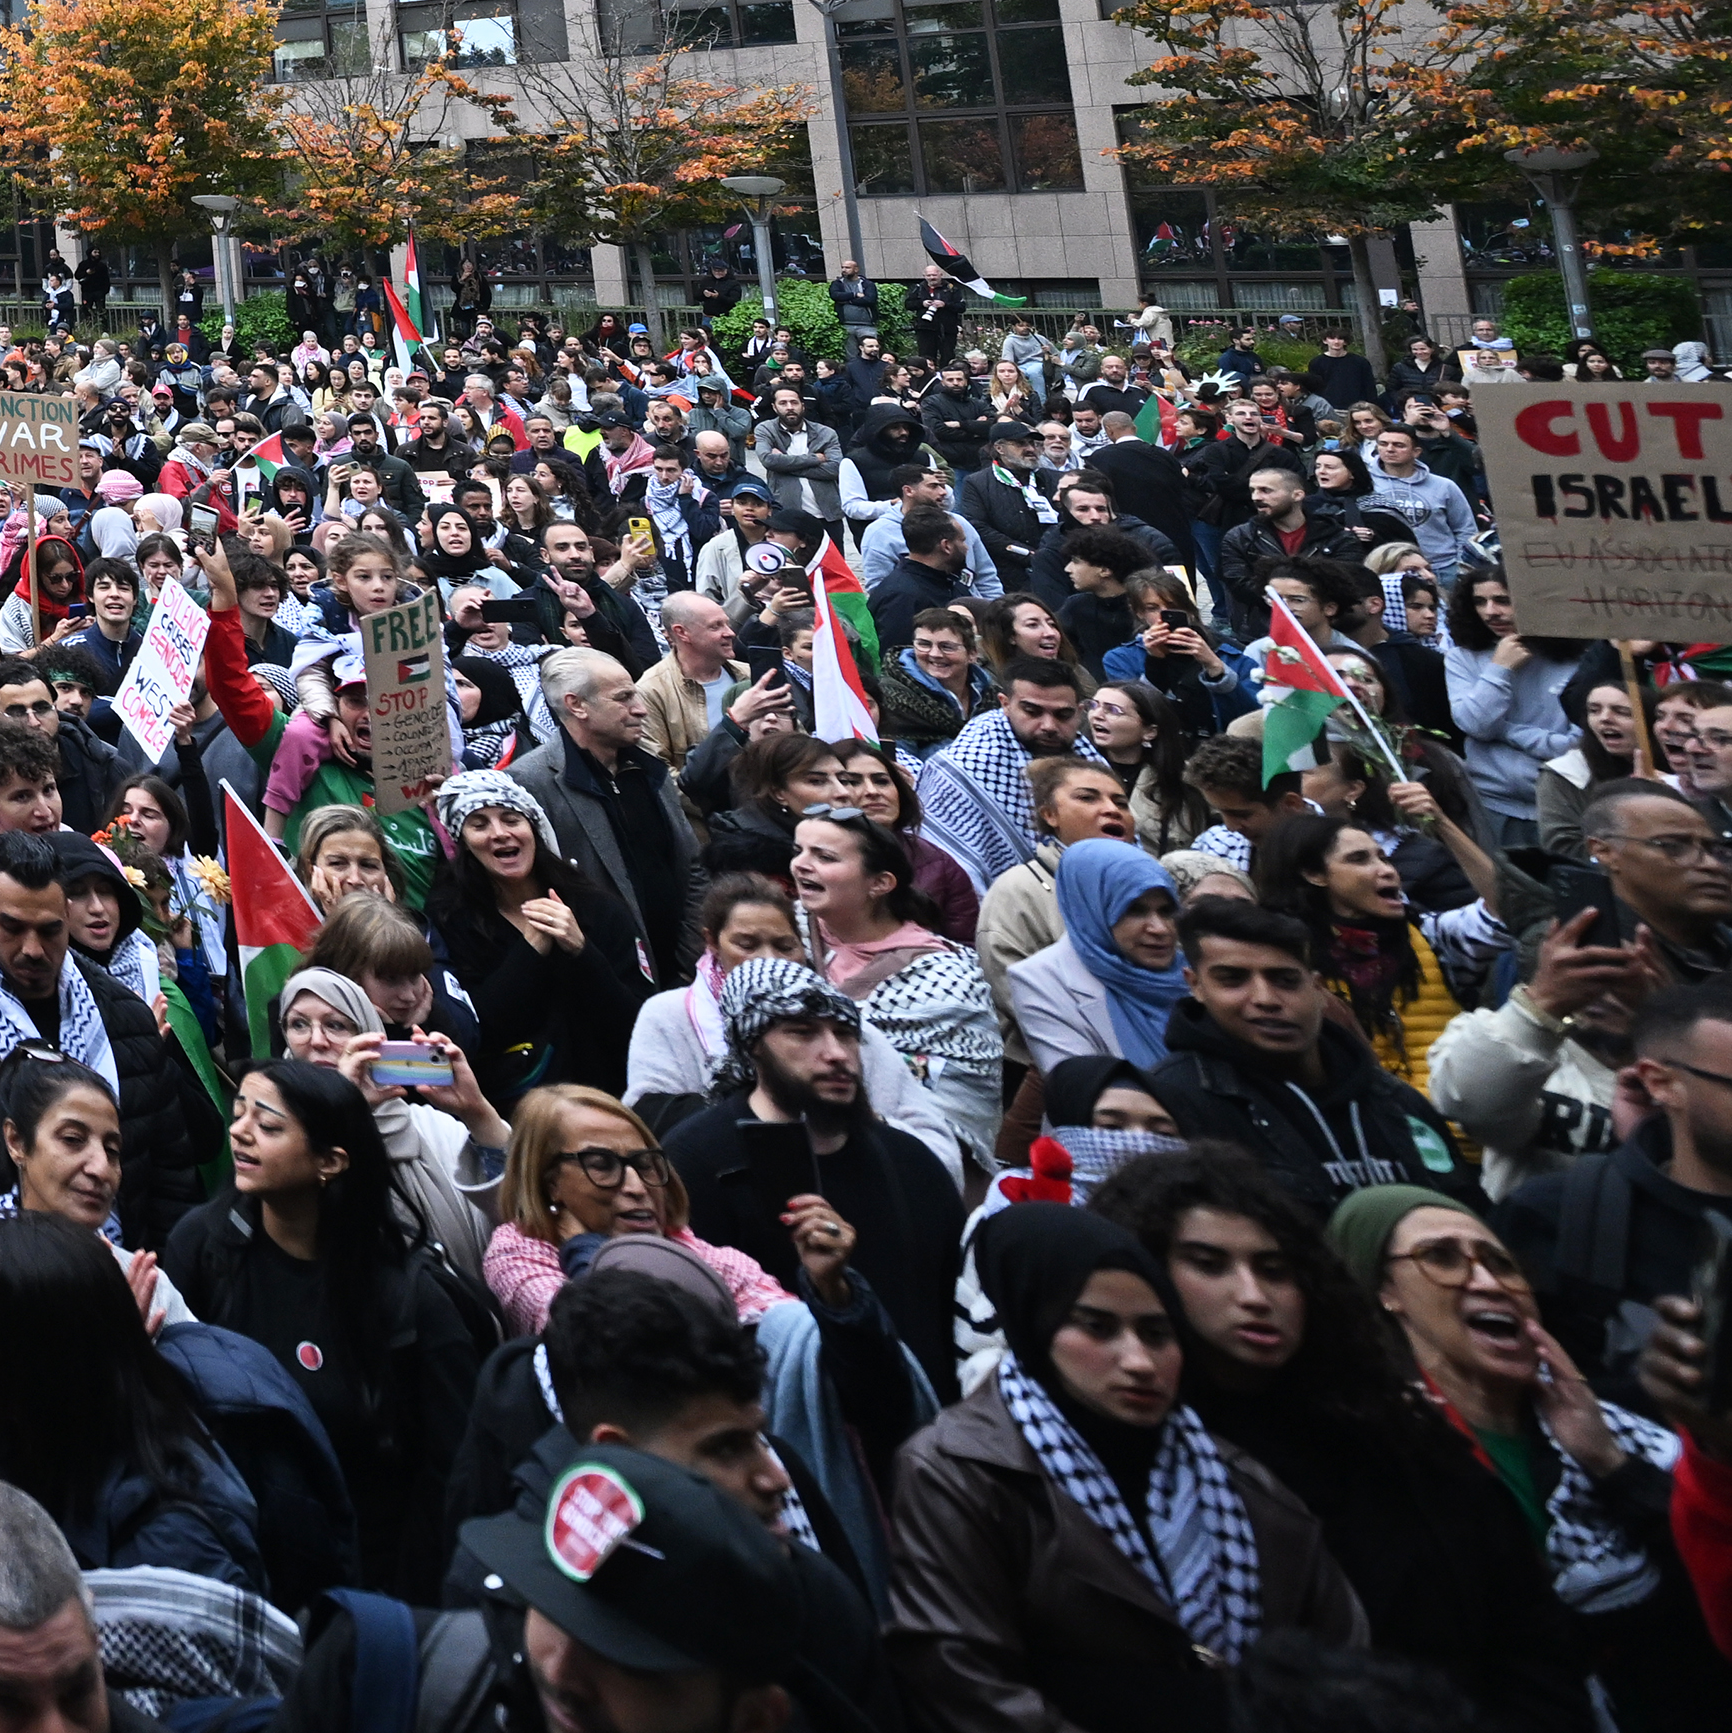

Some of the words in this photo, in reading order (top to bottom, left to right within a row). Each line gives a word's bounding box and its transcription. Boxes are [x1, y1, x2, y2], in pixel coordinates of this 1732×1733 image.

[1514, 400, 1723, 463] CUT
[1531, 474, 1732, 524] ISRAEL
[160, 614, 195, 665] CAUSES
[372, 595, 437, 655] FREE
[376, 687, 428, 716] STOP
